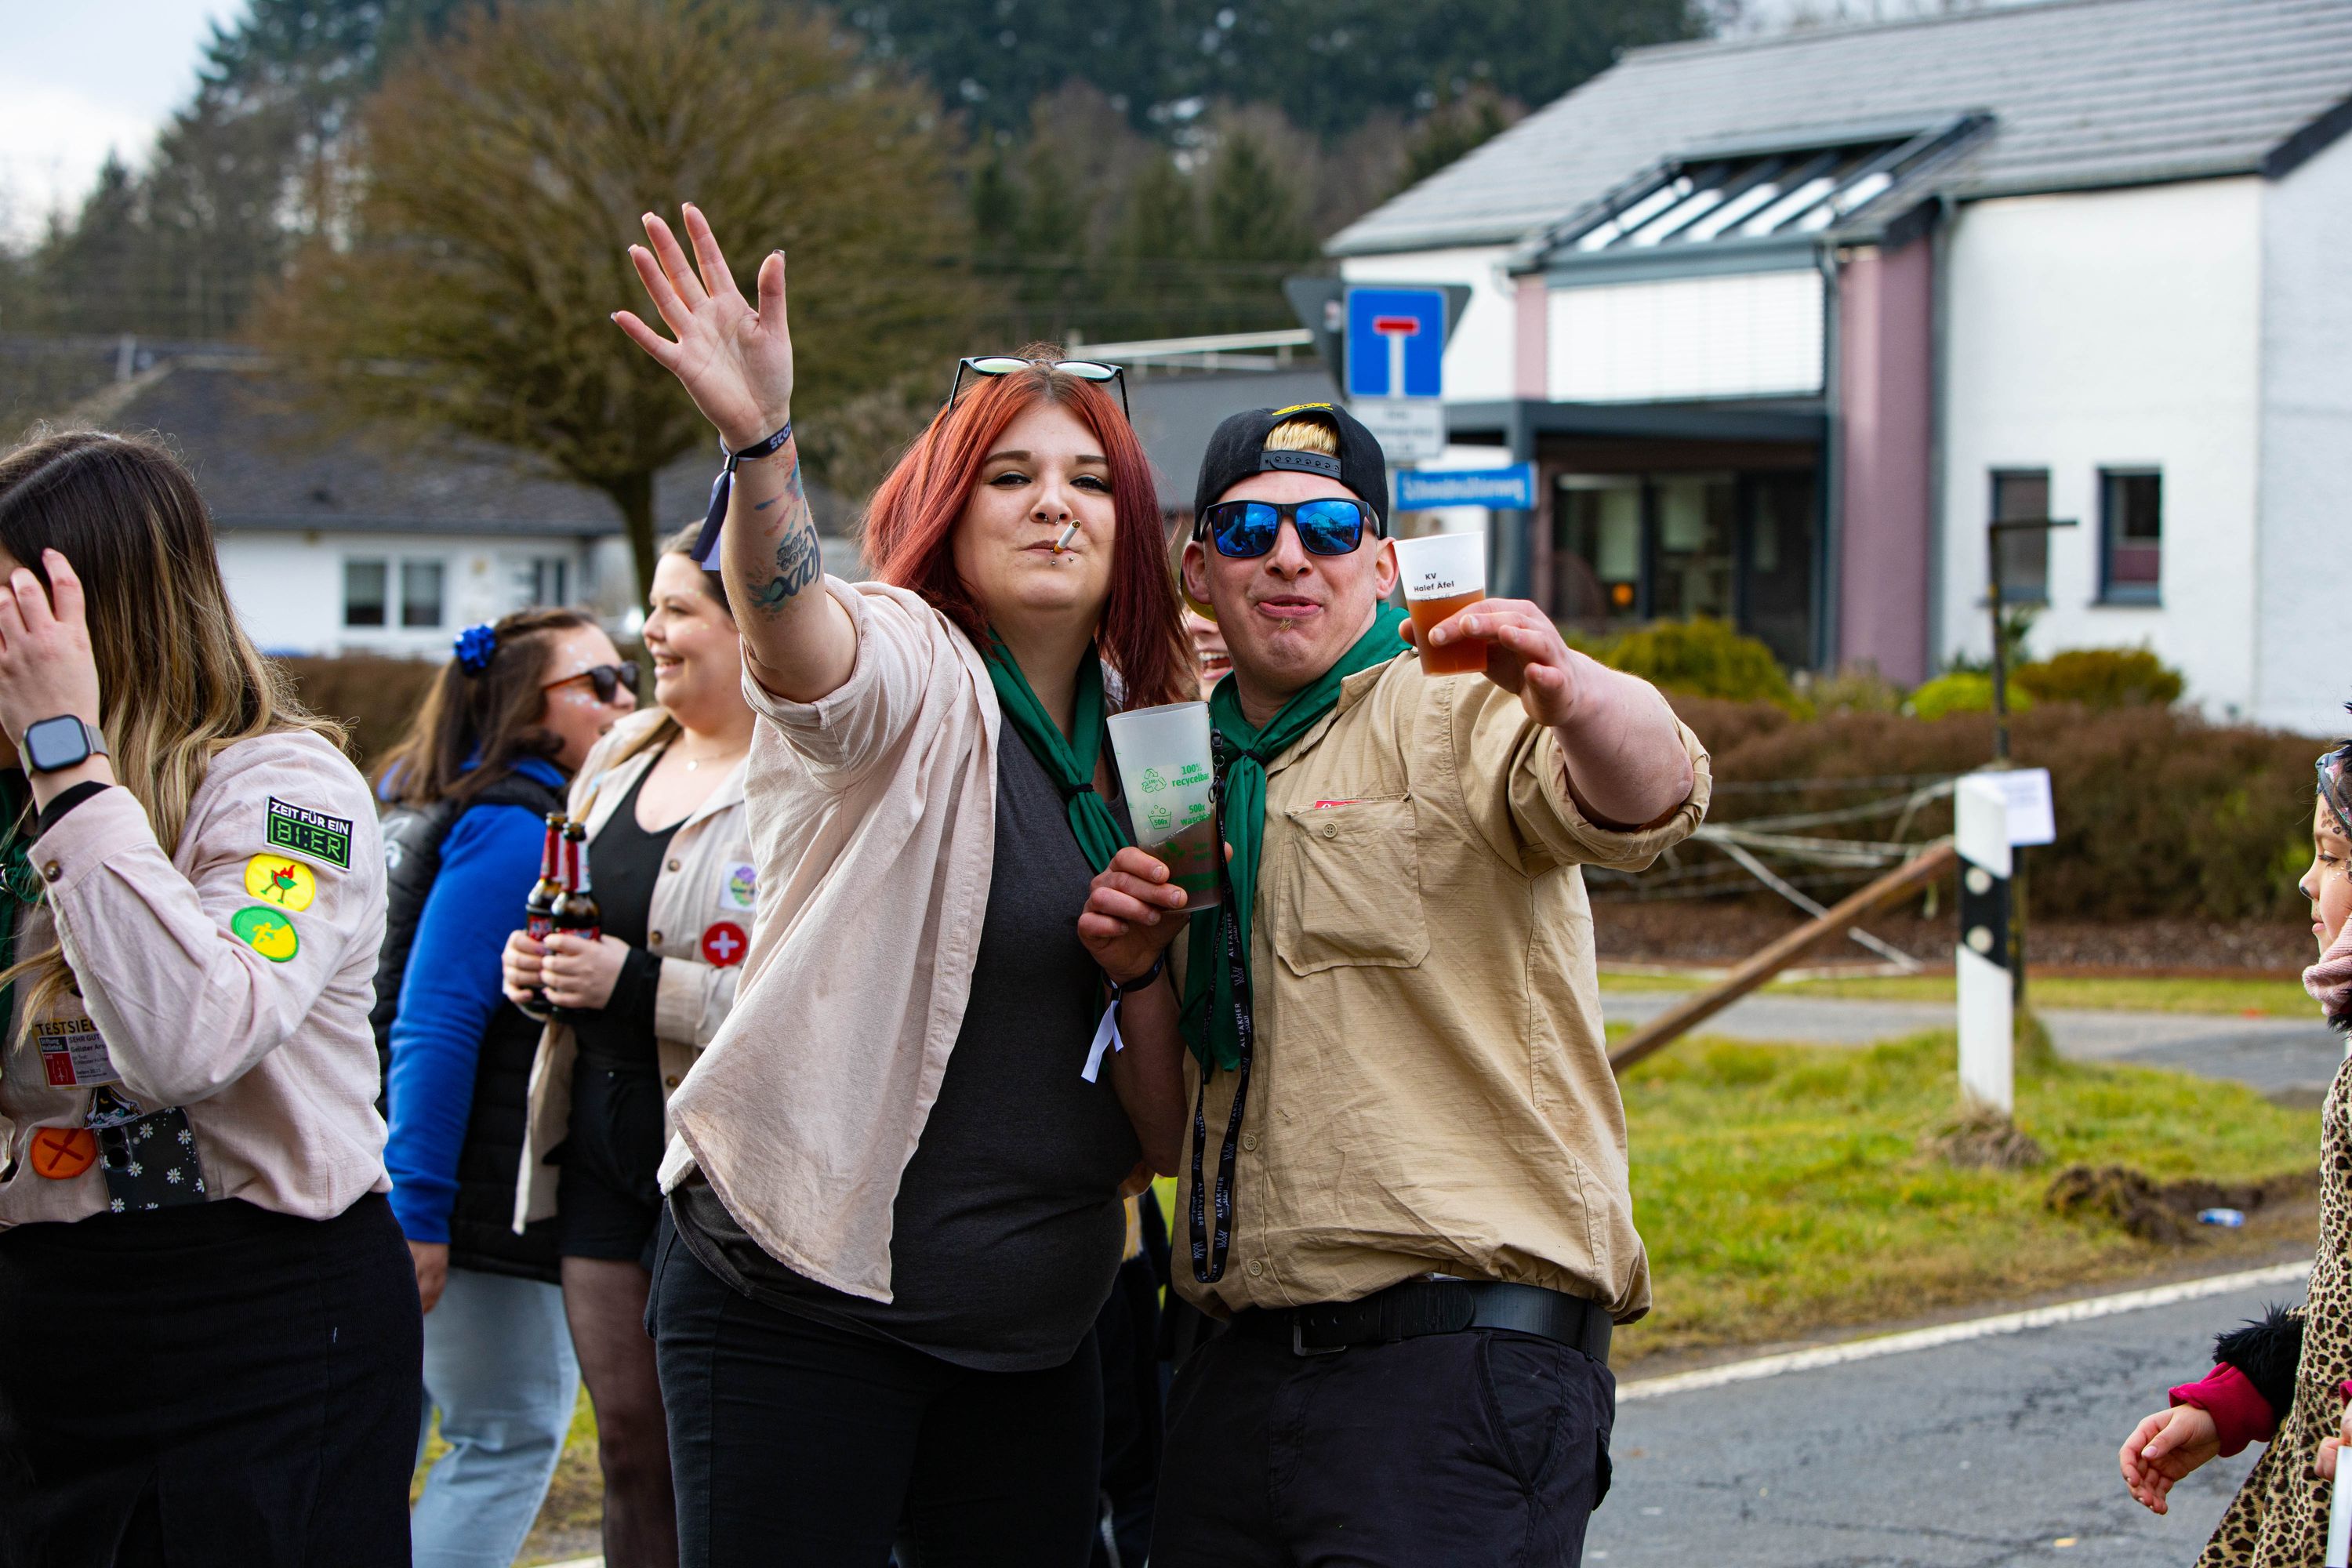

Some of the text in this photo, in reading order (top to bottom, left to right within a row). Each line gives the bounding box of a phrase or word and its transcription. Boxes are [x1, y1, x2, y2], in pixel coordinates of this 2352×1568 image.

[1437, 581, 1454, 590] Äfel
[1181, 764, 1202, 775] 100%
[1189, 804, 1205, 814] 500x
[270, 801, 349, 835] ZEIT FÜR EIN
[1229, 946, 1234, 957] AL
[1235, 1003, 1246, 1047] AL FAKHER
[1198, 1182, 1203, 1192] AL
[1215, 1177, 1224, 1218] AL FAKHER
